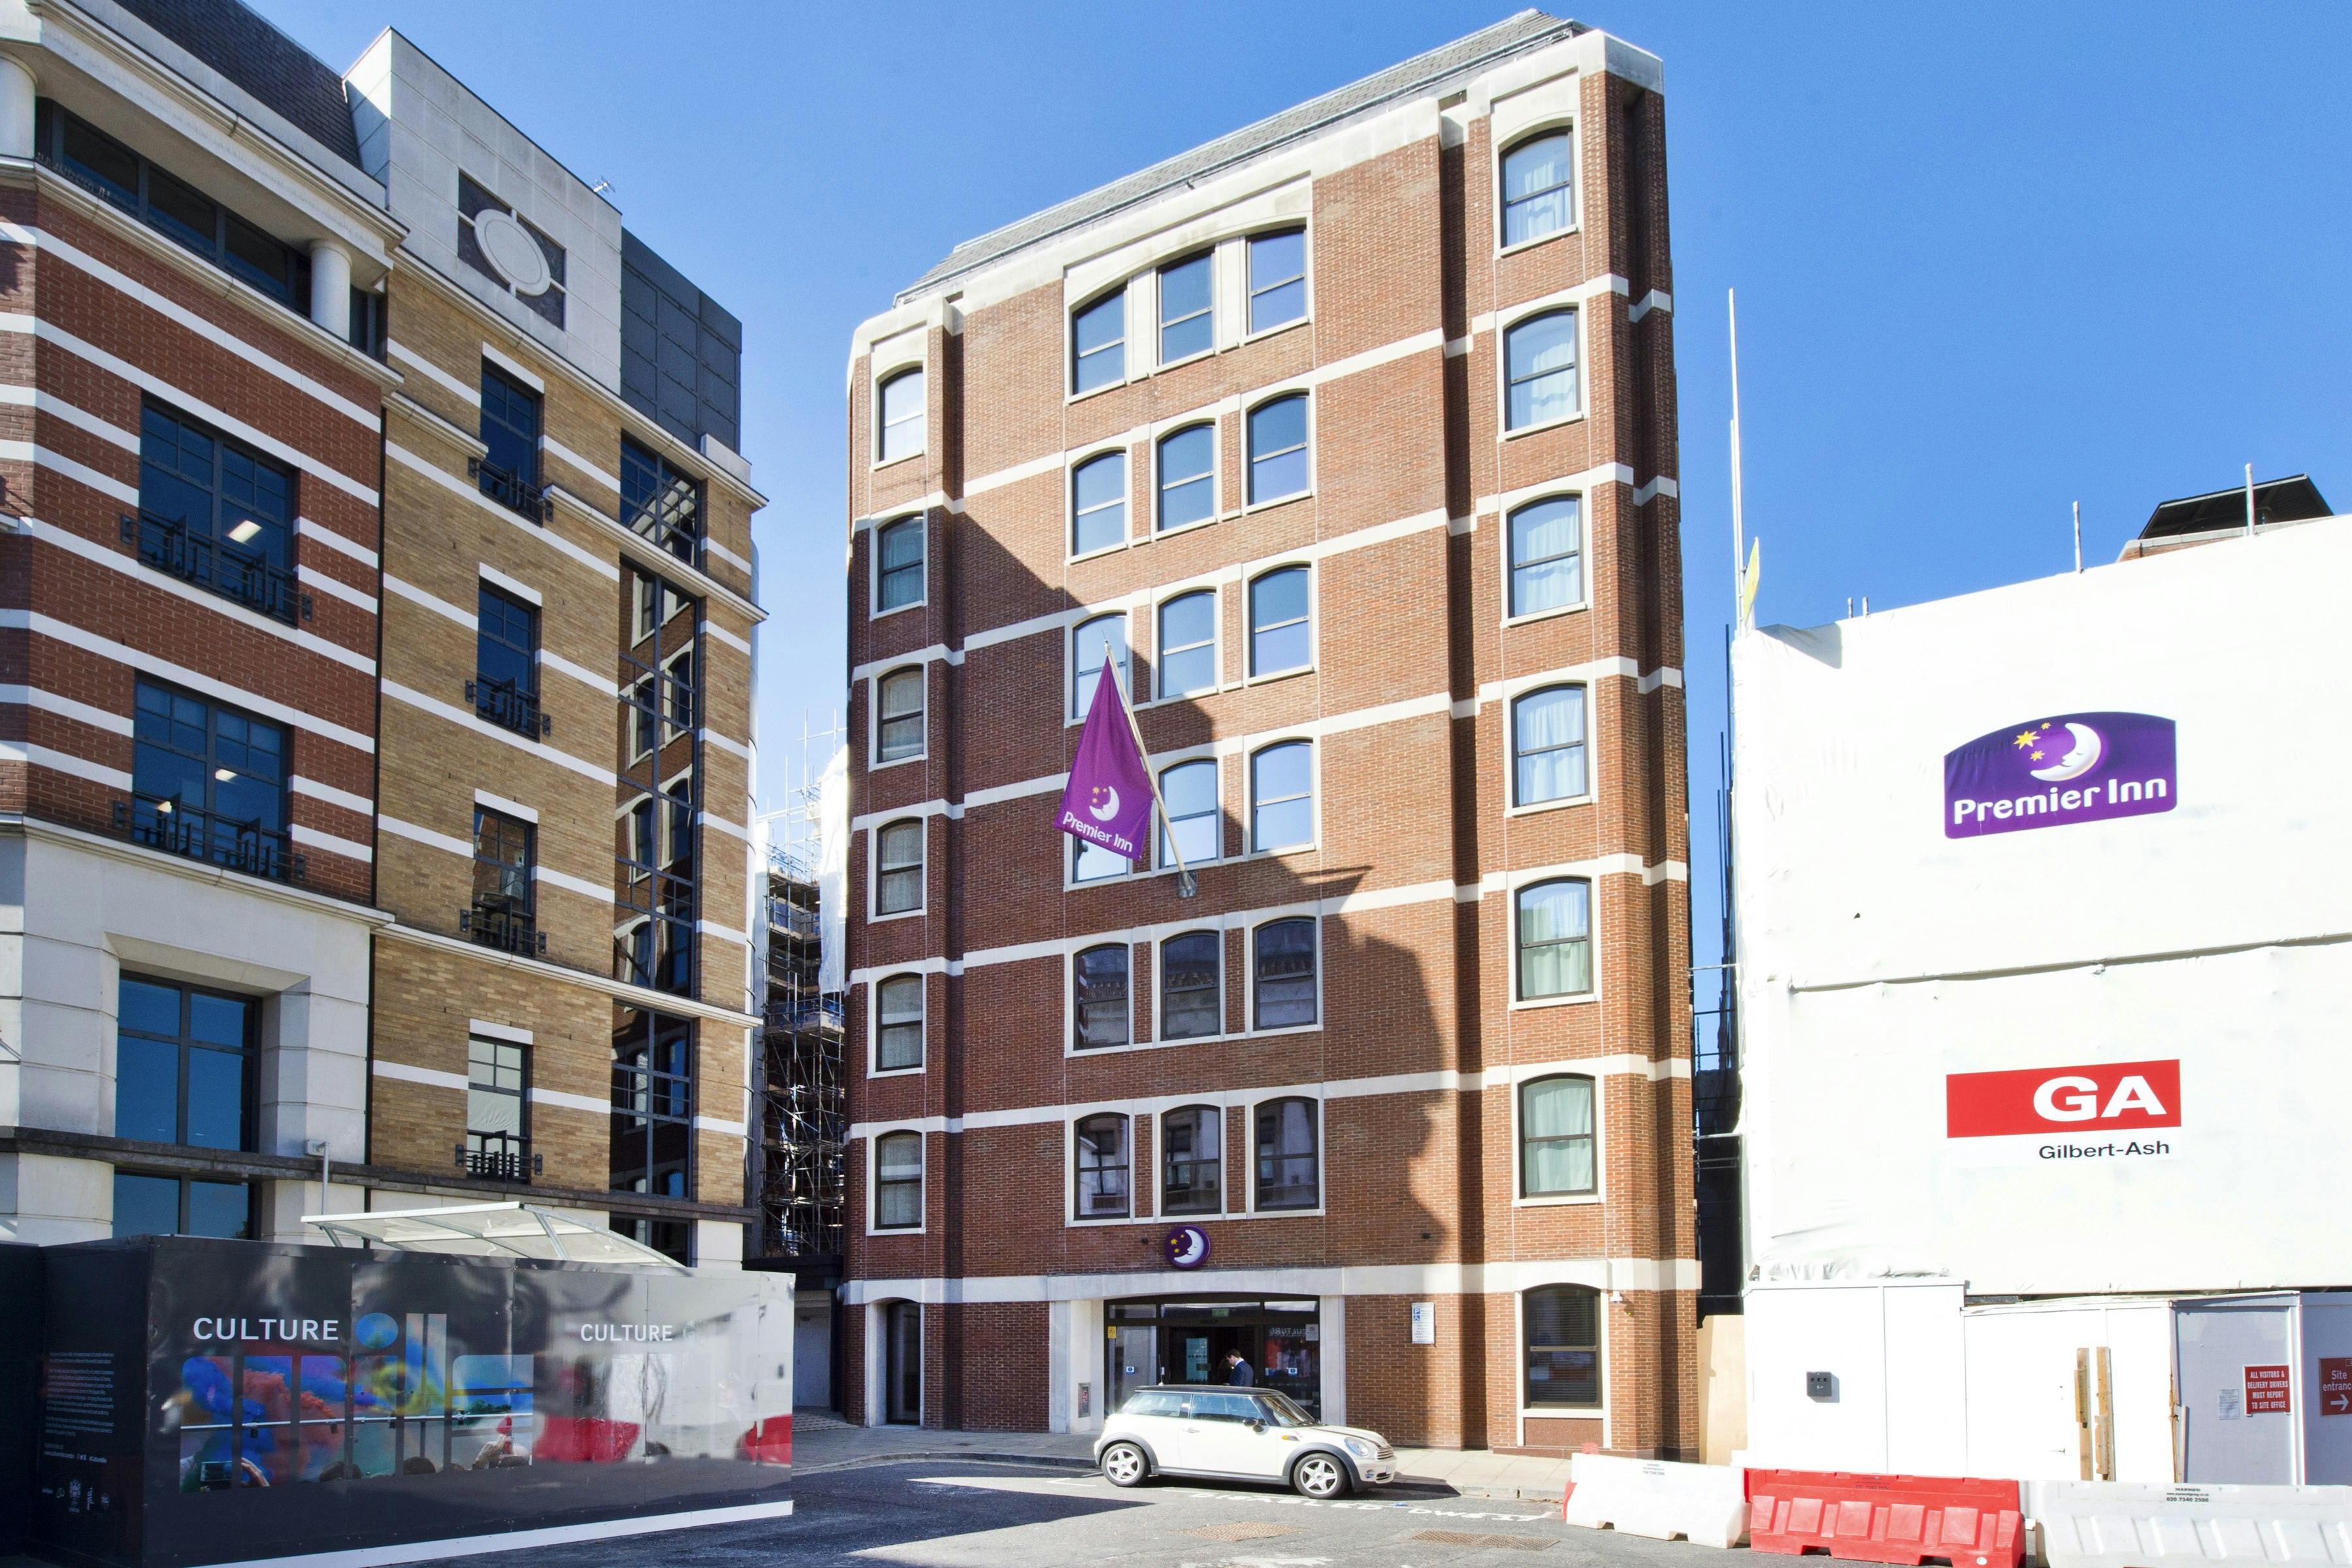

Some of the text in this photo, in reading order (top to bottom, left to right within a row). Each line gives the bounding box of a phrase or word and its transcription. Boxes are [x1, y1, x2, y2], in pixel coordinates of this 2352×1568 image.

[1953, 777, 2168, 825] Premier Inn
[1062, 810, 1133, 853] Premier Inn
[2033, 1075, 2167, 1122] GA
[2038, 1141, 2170, 1160] Gilbert-Ash
[193, 1316, 339, 1341] CULTURE
[580, 1324, 674, 1342] CULTURE
[2331, 1369, 2347, 1380] Site
